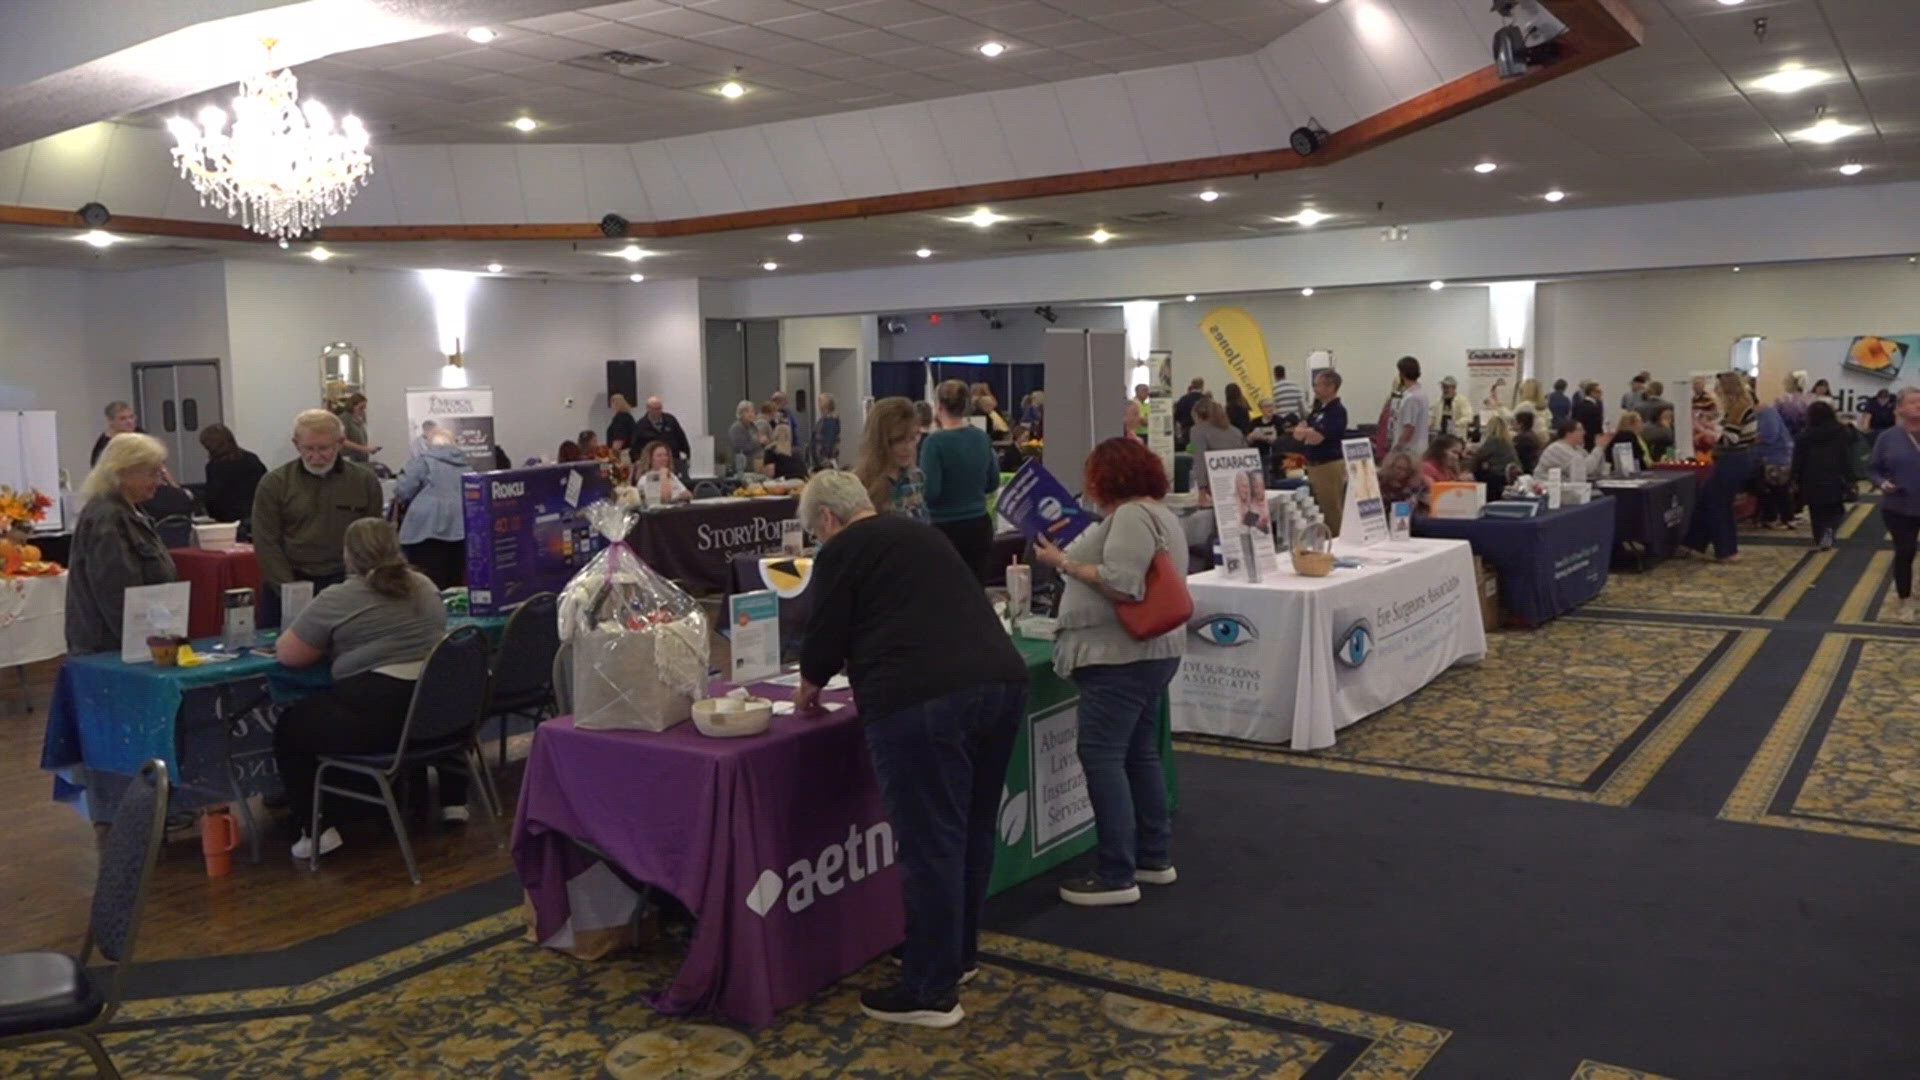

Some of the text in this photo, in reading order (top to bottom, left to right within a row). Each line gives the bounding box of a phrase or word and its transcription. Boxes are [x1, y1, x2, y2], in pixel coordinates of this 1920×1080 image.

[1208, 455, 1260, 470] CATARACTS
[1203, 664, 1261, 680] SURGEONS
[1183, 674, 1261, 692] ASSOCIATES
[786, 820, 899, 914] aetn
